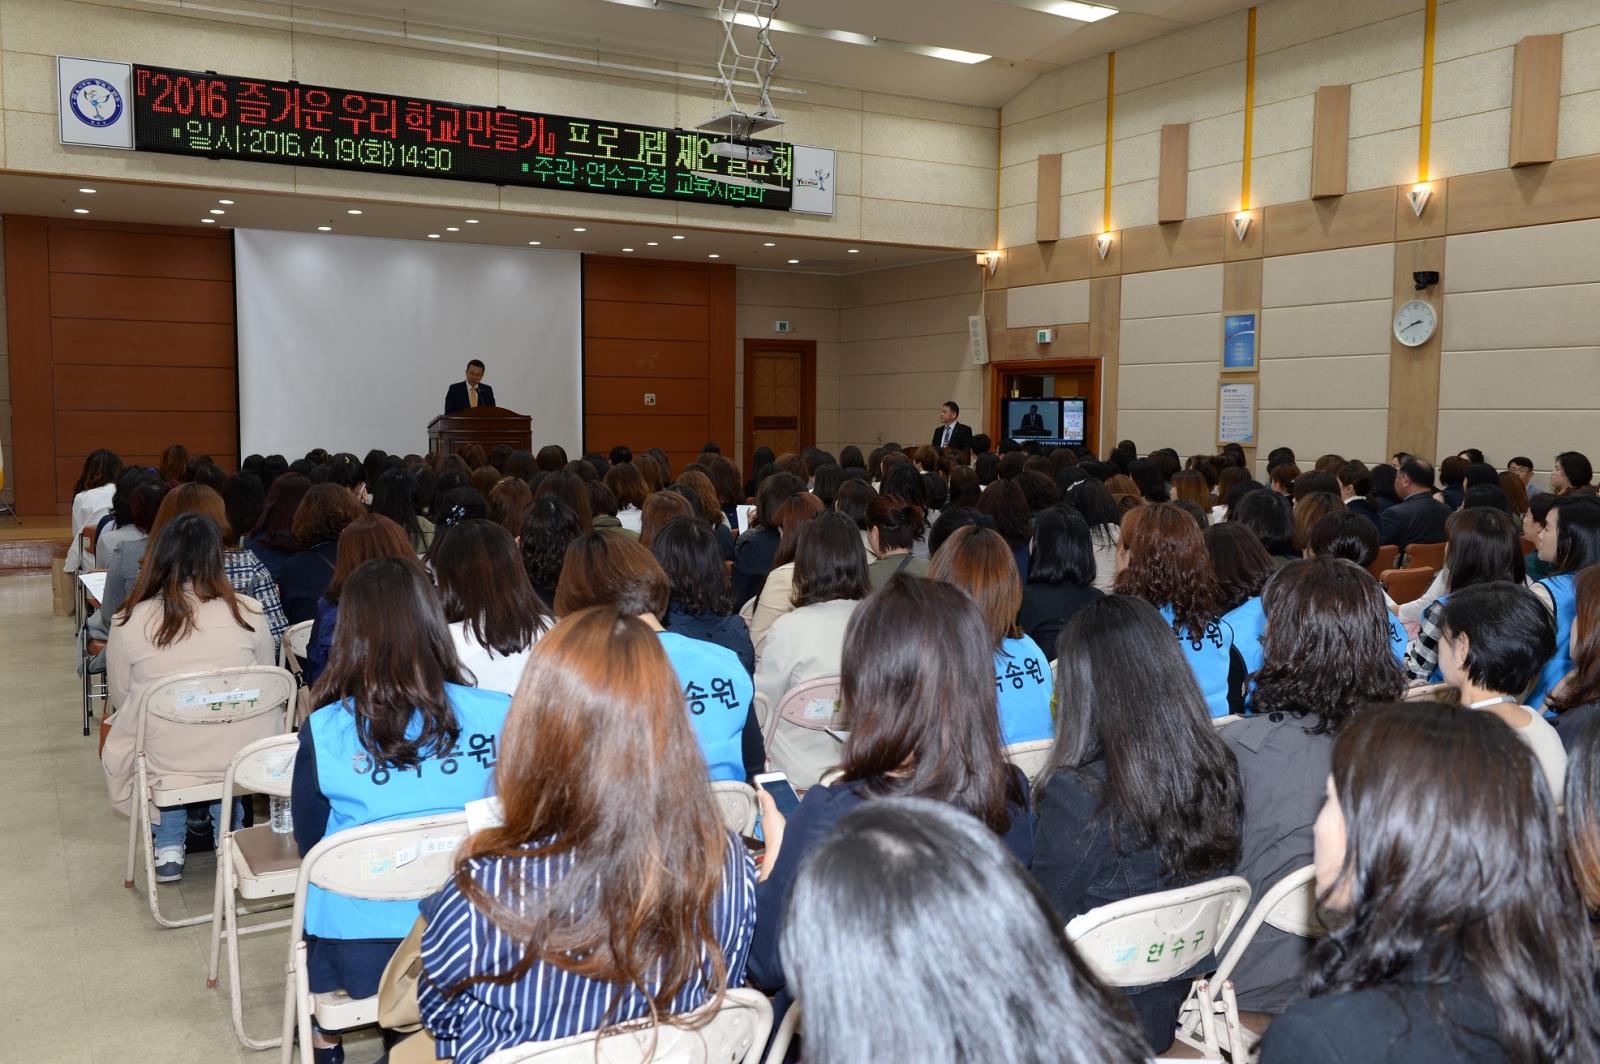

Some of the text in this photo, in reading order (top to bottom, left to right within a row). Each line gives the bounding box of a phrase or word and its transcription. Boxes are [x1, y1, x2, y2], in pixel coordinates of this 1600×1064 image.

[400, 144, 452, 171] 14:30
[564, 122, 667, 167] 프로그램
[1146, 929, 1205, 963] 연수구
